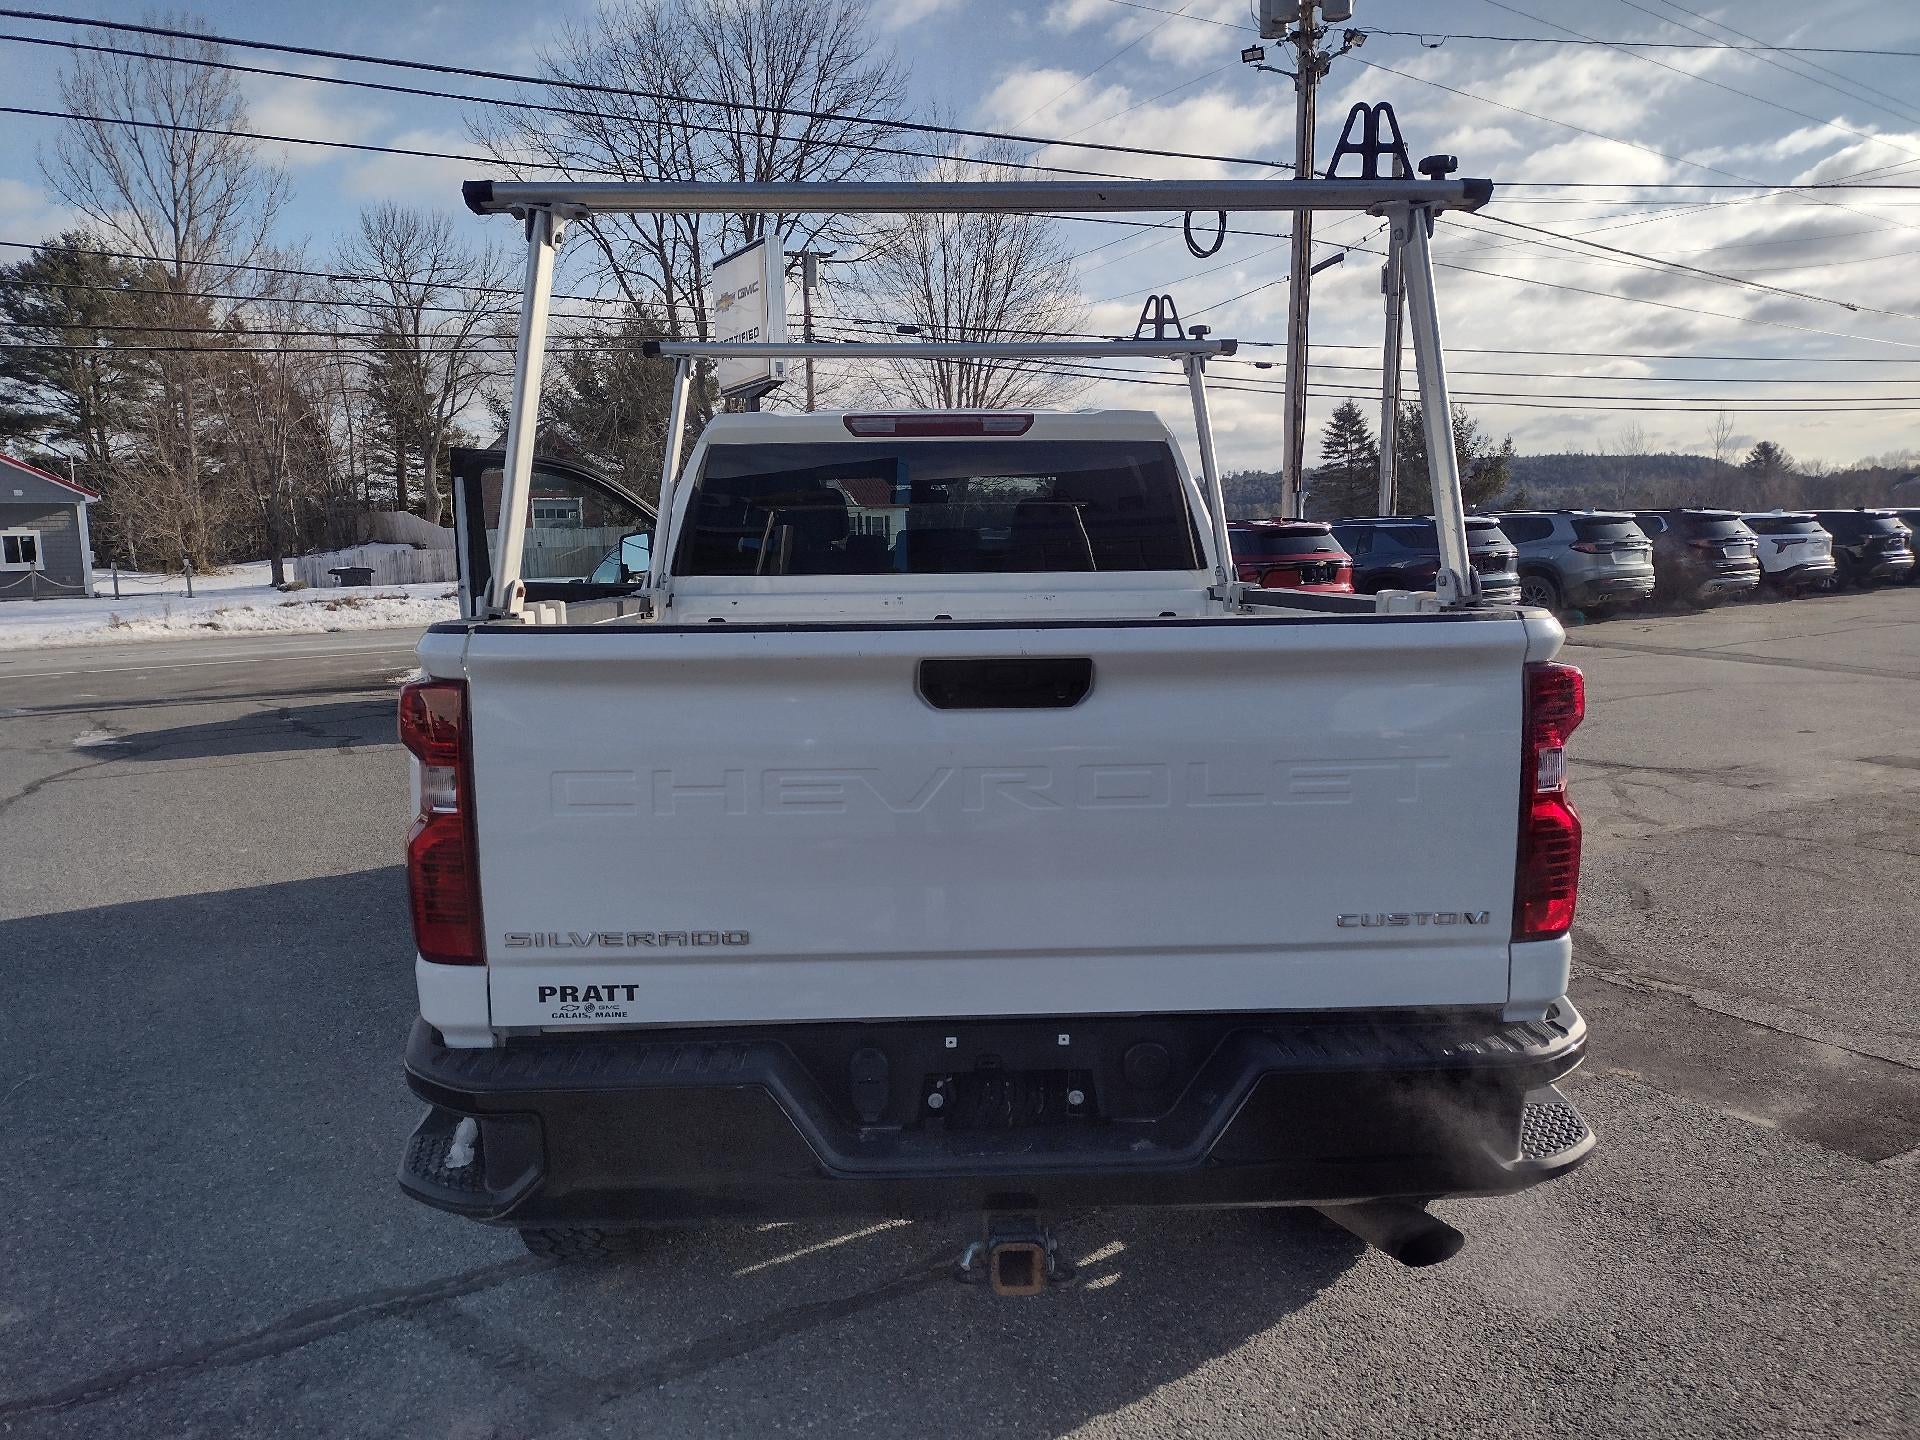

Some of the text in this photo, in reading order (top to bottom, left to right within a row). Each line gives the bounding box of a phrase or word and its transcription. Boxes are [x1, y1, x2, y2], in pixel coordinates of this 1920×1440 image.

[737, 280, 759, 300] GMC
[550, 755, 1450, 816] CHEVROLET
[1336, 911, 1490, 928] CUSTOM
[504, 930, 751, 948] SILVERADO
[538, 984, 639, 1003] PRATT
